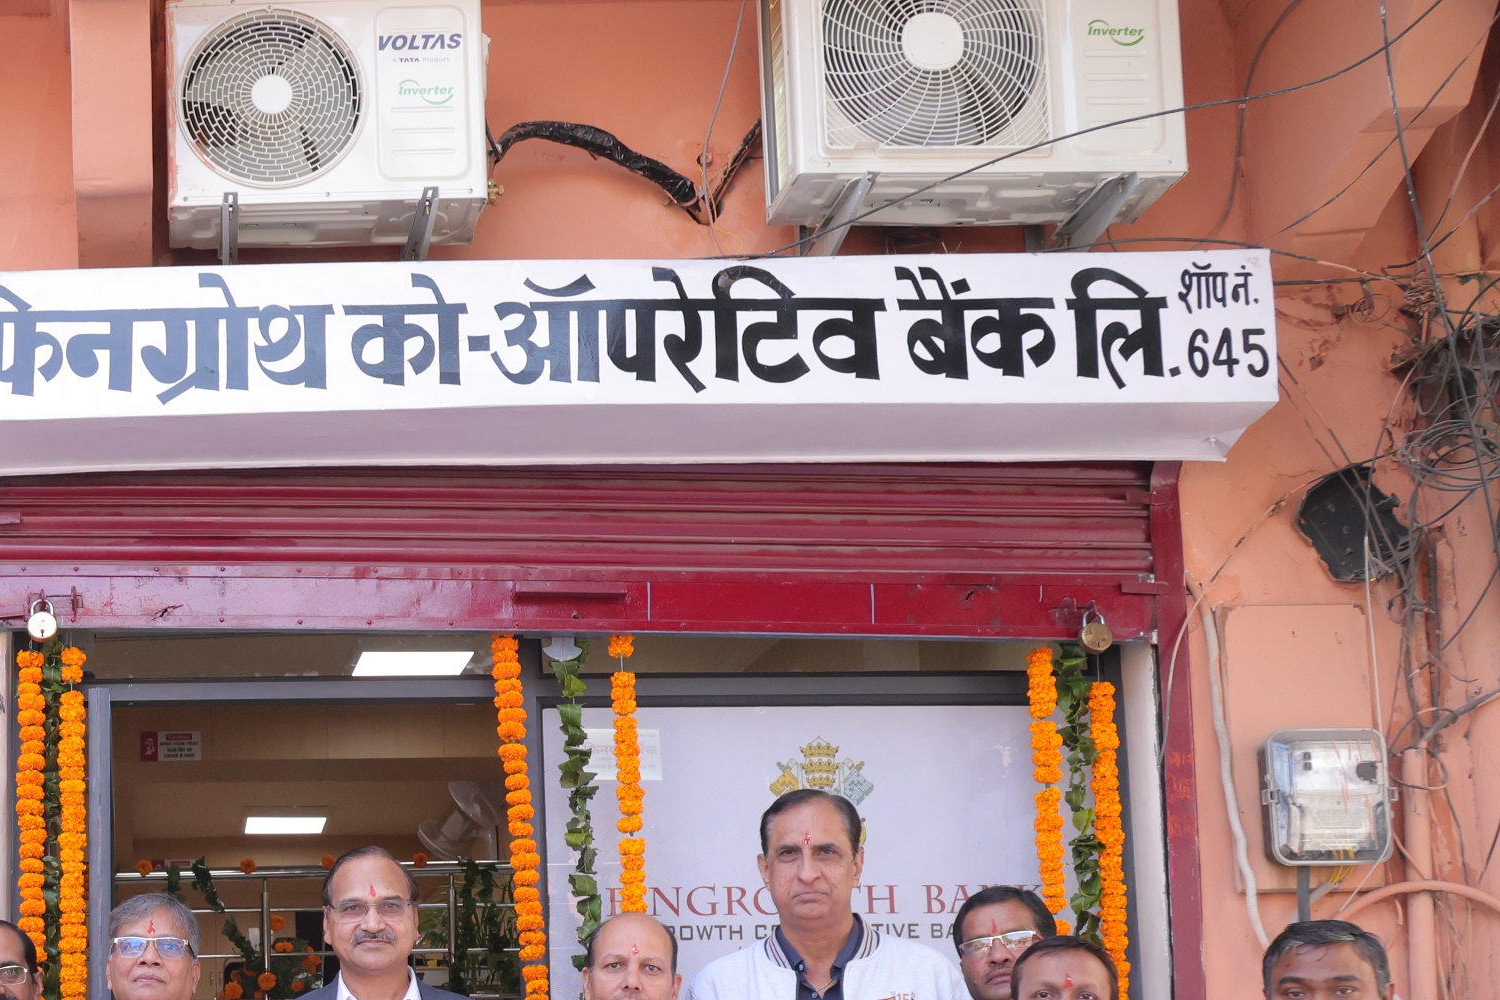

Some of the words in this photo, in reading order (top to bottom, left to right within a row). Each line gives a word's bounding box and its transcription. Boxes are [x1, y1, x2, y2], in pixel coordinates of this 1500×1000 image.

[378, 33, 462, 51] VOLTAS
[1178, 261, 1229, 314] शॉप
[895, 266, 1056, 381] बैंक
[1187, 327, 1270, 378] 645
